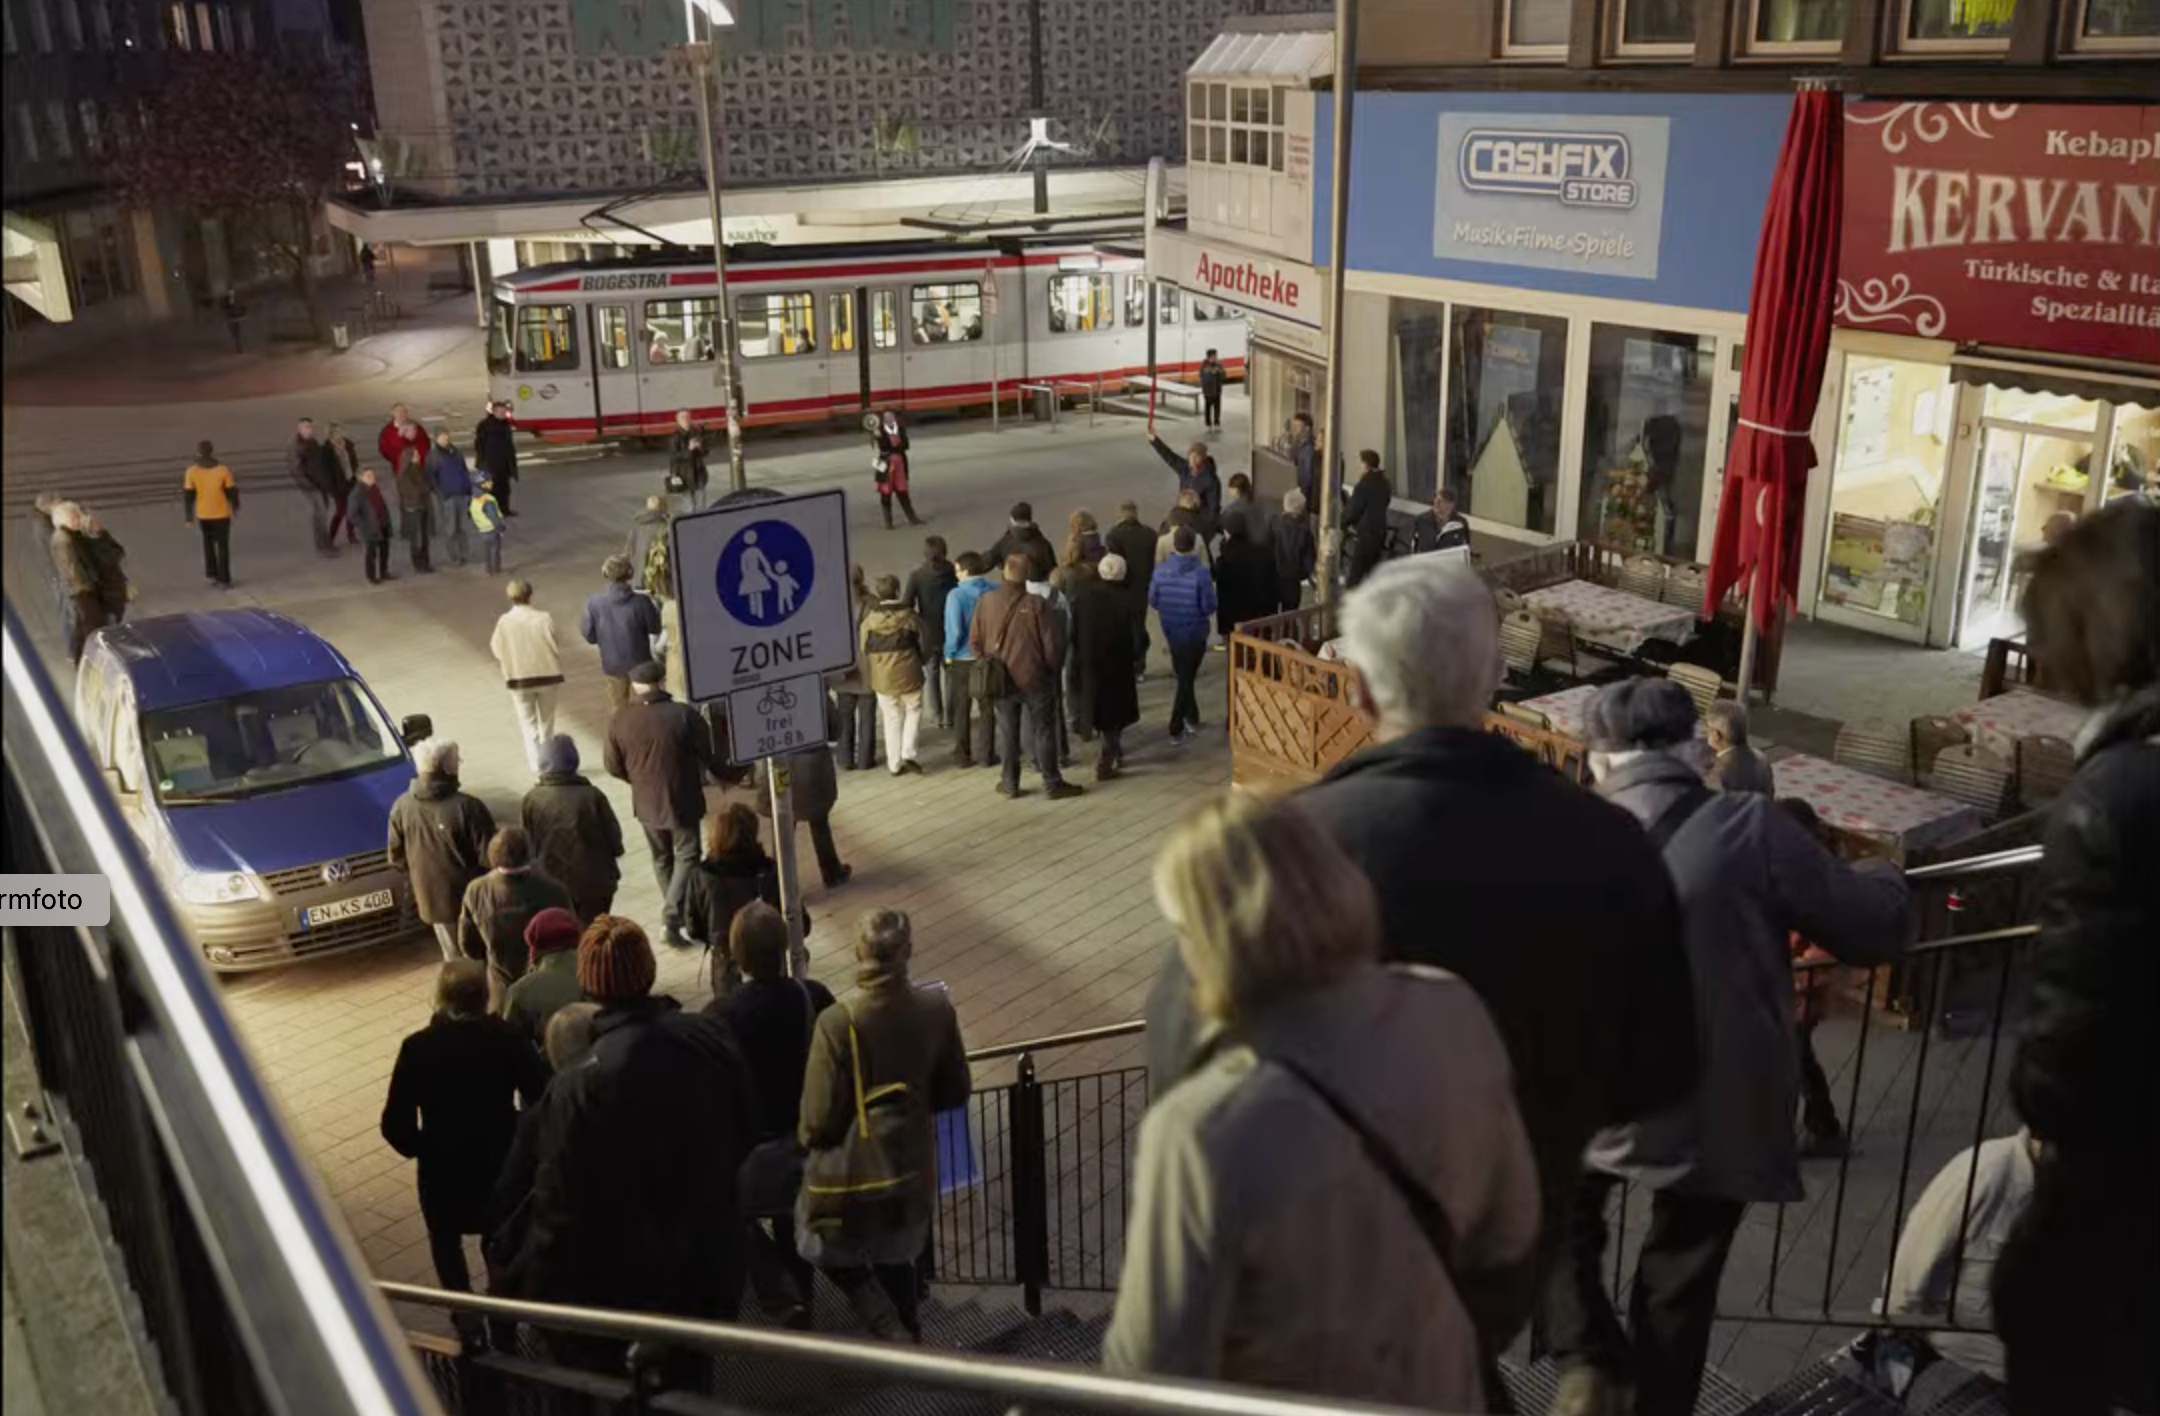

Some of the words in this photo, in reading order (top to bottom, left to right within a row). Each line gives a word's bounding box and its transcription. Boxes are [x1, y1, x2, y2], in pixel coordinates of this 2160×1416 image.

[1469, 140, 1619, 182] CASHFIX
[2045, 130, 2160, 165] Kebap
[1566, 183, 1631, 202] STORE
[1886, 165, 2160, 254] KERVAN
[583, 273, 667, 290] BOGESTRA
[1196, 252, 1299, 307] Apotheke
[1964, 259, 2089, 288] Türkische
[2097, 270, 2122, 292] &
[731, 631, 814, 675] ZONE
[766, 714, 793, 731] frei
